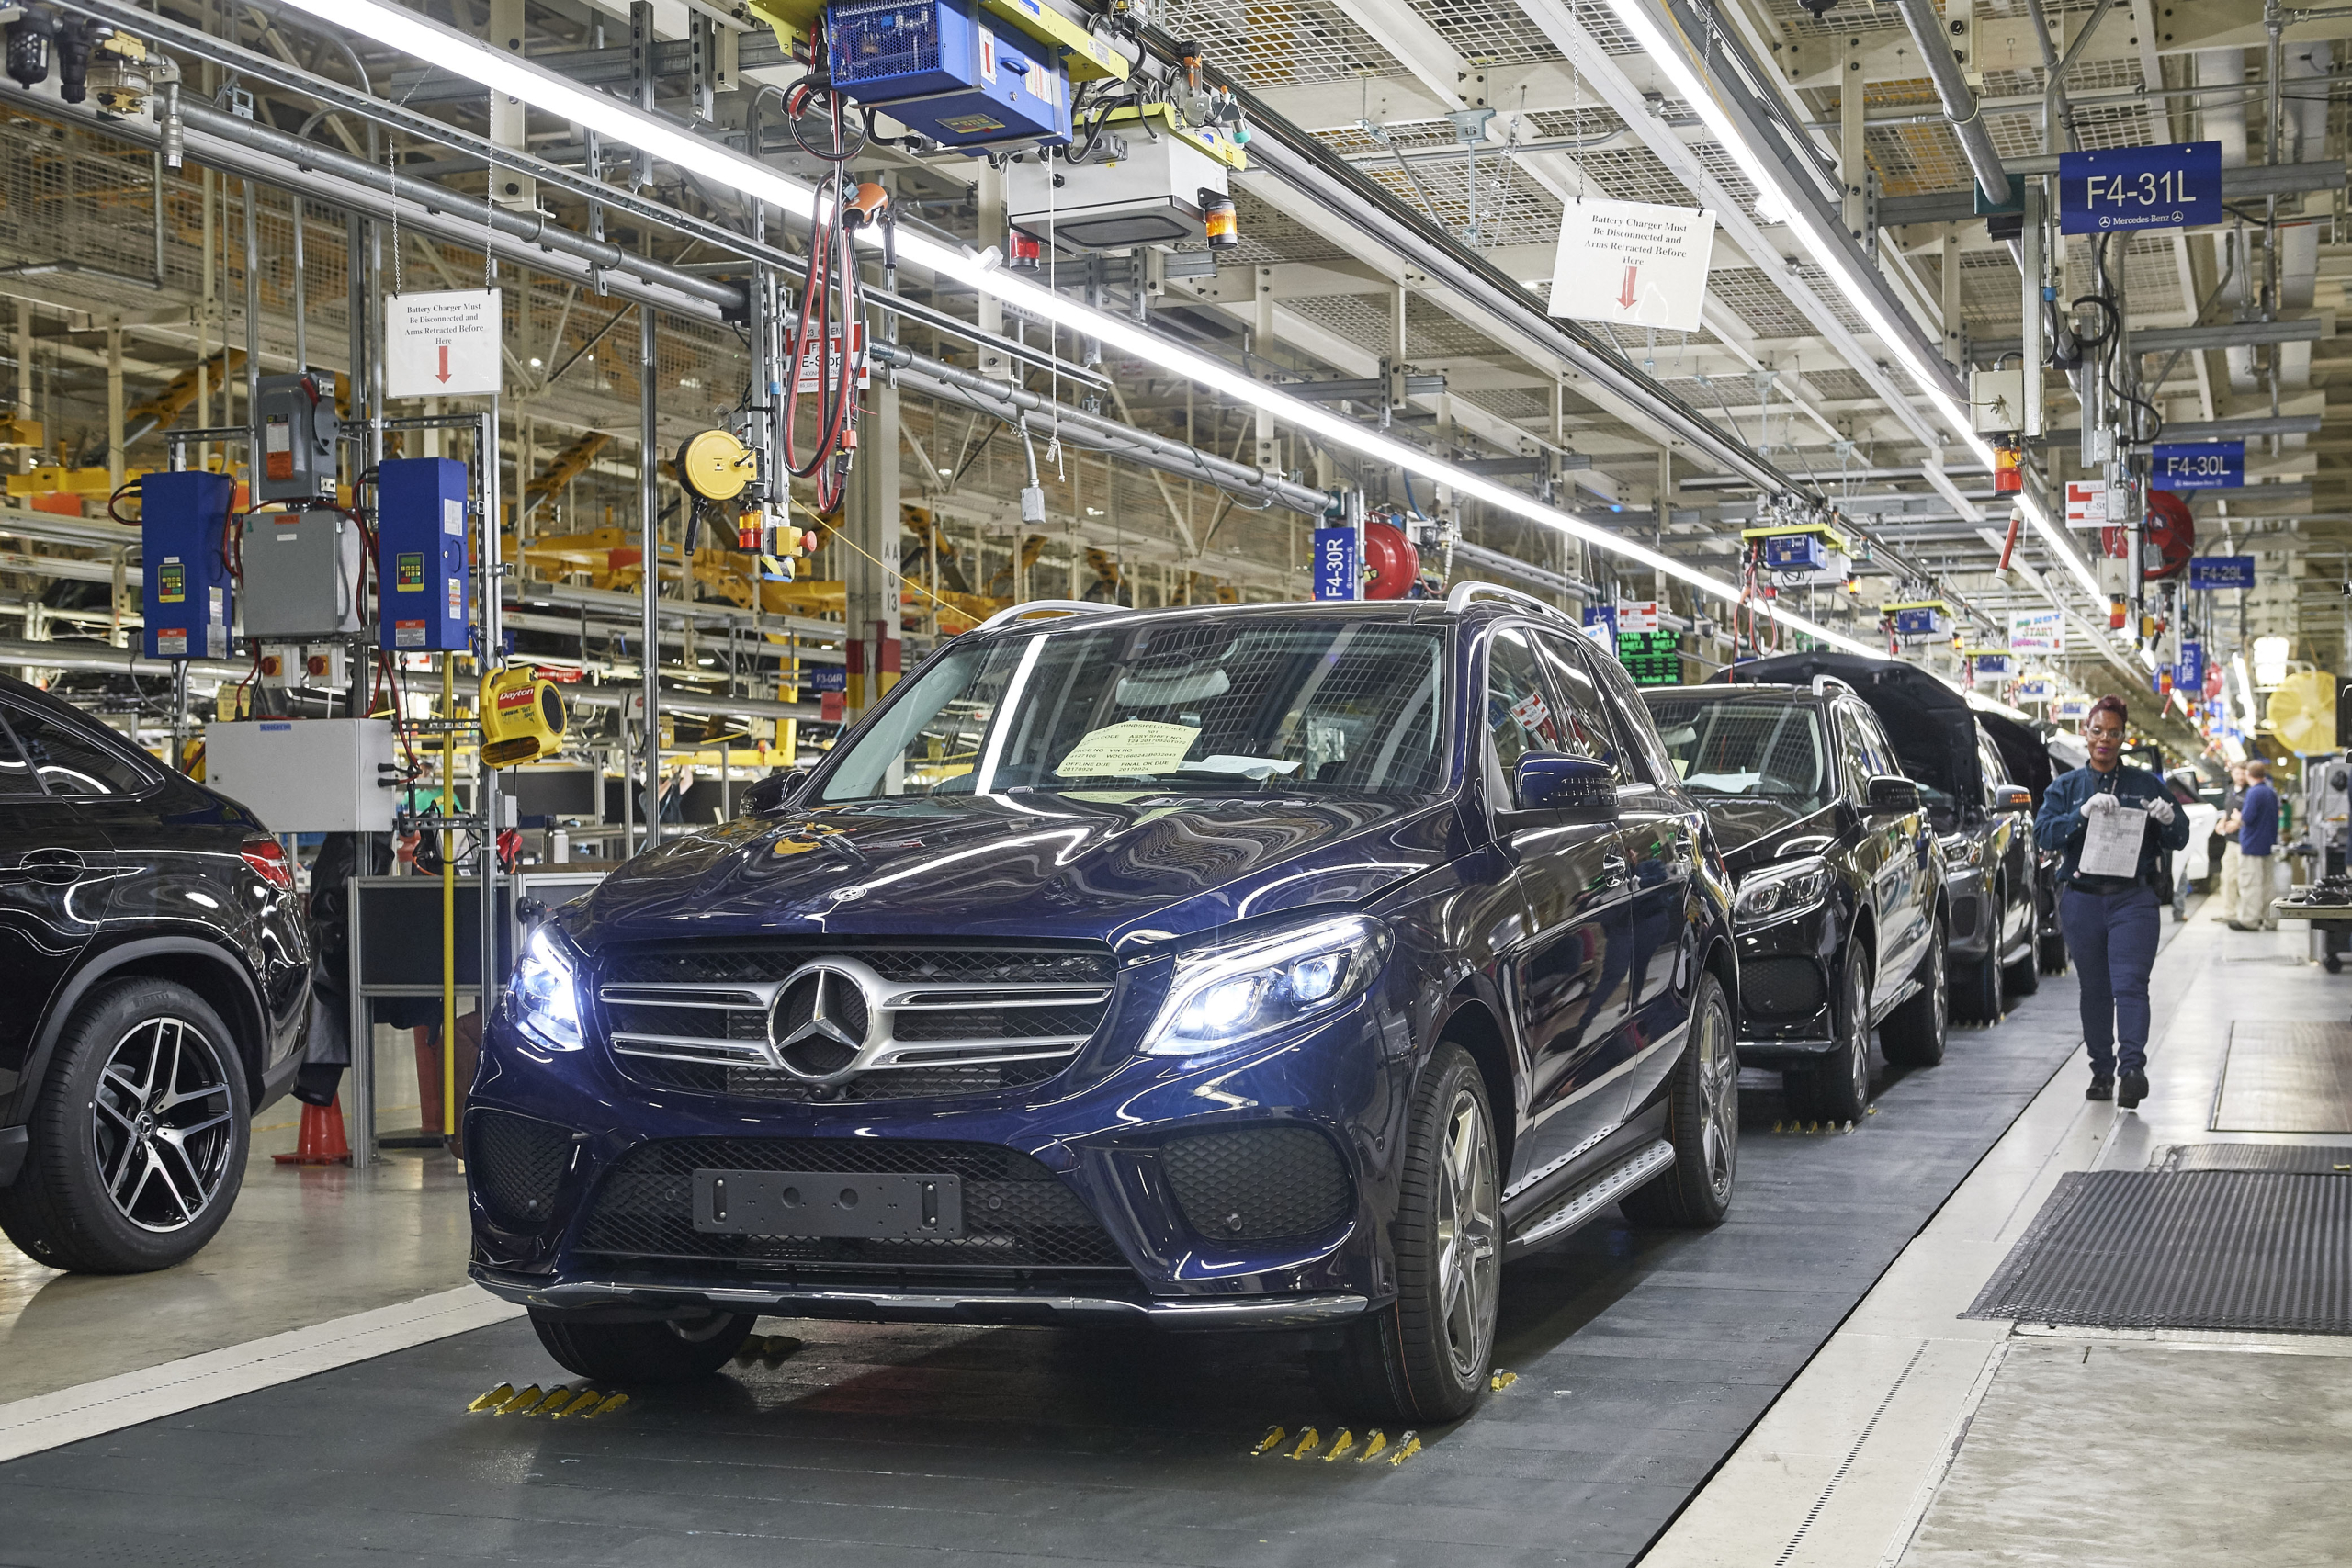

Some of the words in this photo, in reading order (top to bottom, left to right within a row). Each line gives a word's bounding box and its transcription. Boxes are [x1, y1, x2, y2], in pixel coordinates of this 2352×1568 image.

[2087, 170, 2197, 209] F4-31L
[1591, 214, 1623, 226] Battery
[1626, 218, 1663, 231] Charger
[1664, 222, 1688, 233] Must
[2113, 214, 2170, 226] Mercedes-Benz
[1593, 227, 1604, 235] Be
[1606, 228, 1663, 243] Disconnected
[1665, 235, 1682, 244] and
[1584, 240, 1608, 250] Arms
[1611, 242, 1653, 254] Retracted
[1655, 247, 1687, 258] Before
[1623, 256, 1645, 265] Here
[407, 306, 431, 314] Battery
[433, 304, 462, 312] Charger
[420, 314, 464, 323] Disconnected
[424, 326, 458, 334] Retracted
[458, 324, 484, 333] Before
[802, 355, 841, 369] E-Sop
[2167, 456, 2231, 477] F4-30L
[1326, 538, 1344, 597] F4-30R
[887, 592, 898, 613] 13
[816, 672, 843, 684] F3-04R
[499, 688, 535, 701] Dayton
